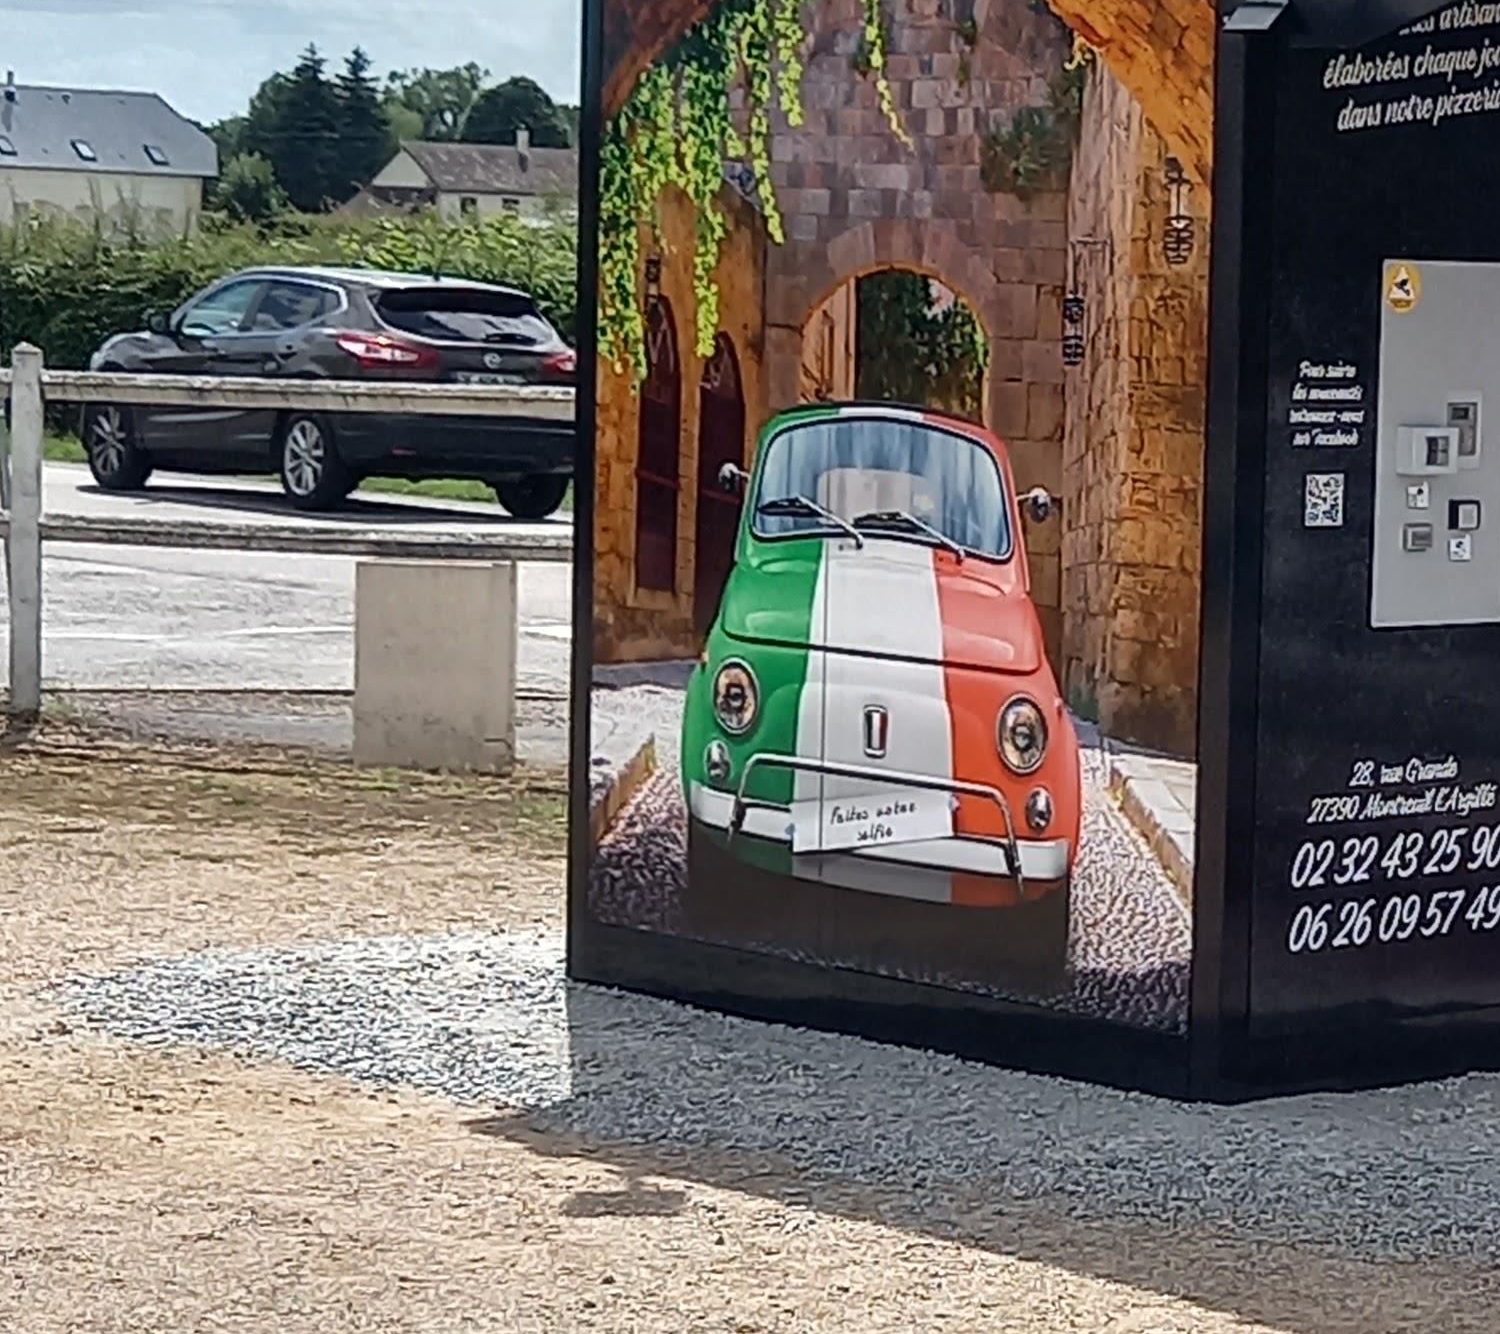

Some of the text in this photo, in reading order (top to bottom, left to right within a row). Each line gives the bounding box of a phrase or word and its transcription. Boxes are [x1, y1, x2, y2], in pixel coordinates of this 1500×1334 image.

[1323, 51, 1410, 89] élaborées
[1413, 44, 1478, 82] chaque
[1337, 97, 1383, 131] dans
[1385, 94, 1434, 124] notre
[1306, 794, 1361, 824] 27390
[857, 823, 894, 842] selfie
[1291, 840, 1335, 888] 02
[1333, 836, 1379, 884] 32
[1380, 832, 1424, 878] 43
[1423, 827, 1469, 875] 25
[1289, 903, 1333, 952] 06
[1332, 899, 1377, 947] 26
[1378, 894, 1421, 942] 09
[1420, 889, 1466, 936] 57
